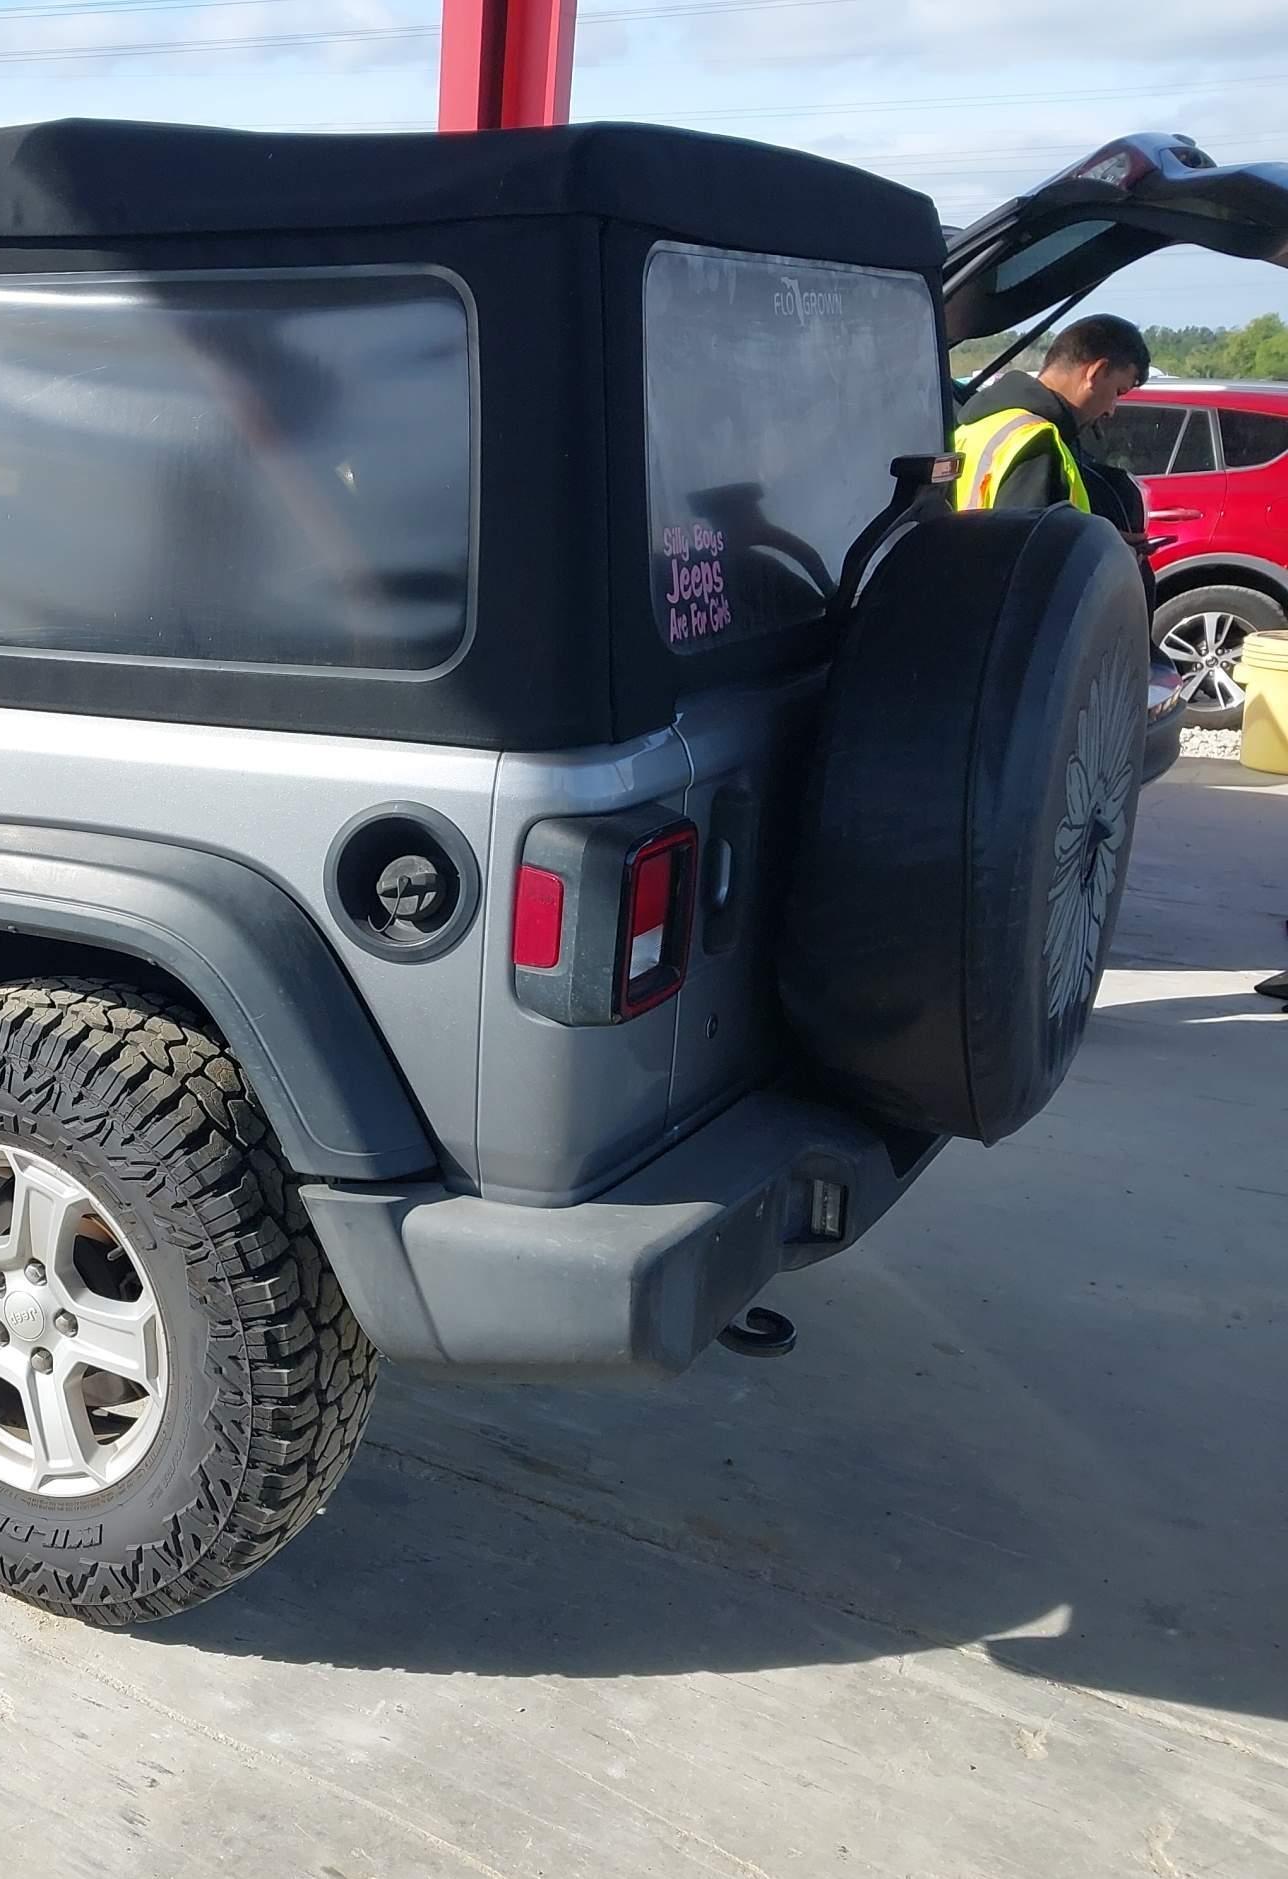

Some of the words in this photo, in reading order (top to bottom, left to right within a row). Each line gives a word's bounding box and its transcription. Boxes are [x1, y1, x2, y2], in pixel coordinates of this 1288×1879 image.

[803, 291, 842, 316] GROWN
[663, 527, 689, 561] Silly
[694, 524, 724, 556] Boys
[666, 559, 724, 604] Jeeps
[670, 607, 689, 643] Are
[690, 603, 708, 637] For
[710, 594, 731, 633] Girls
[11, 1307, 38, 1326] Jeep
